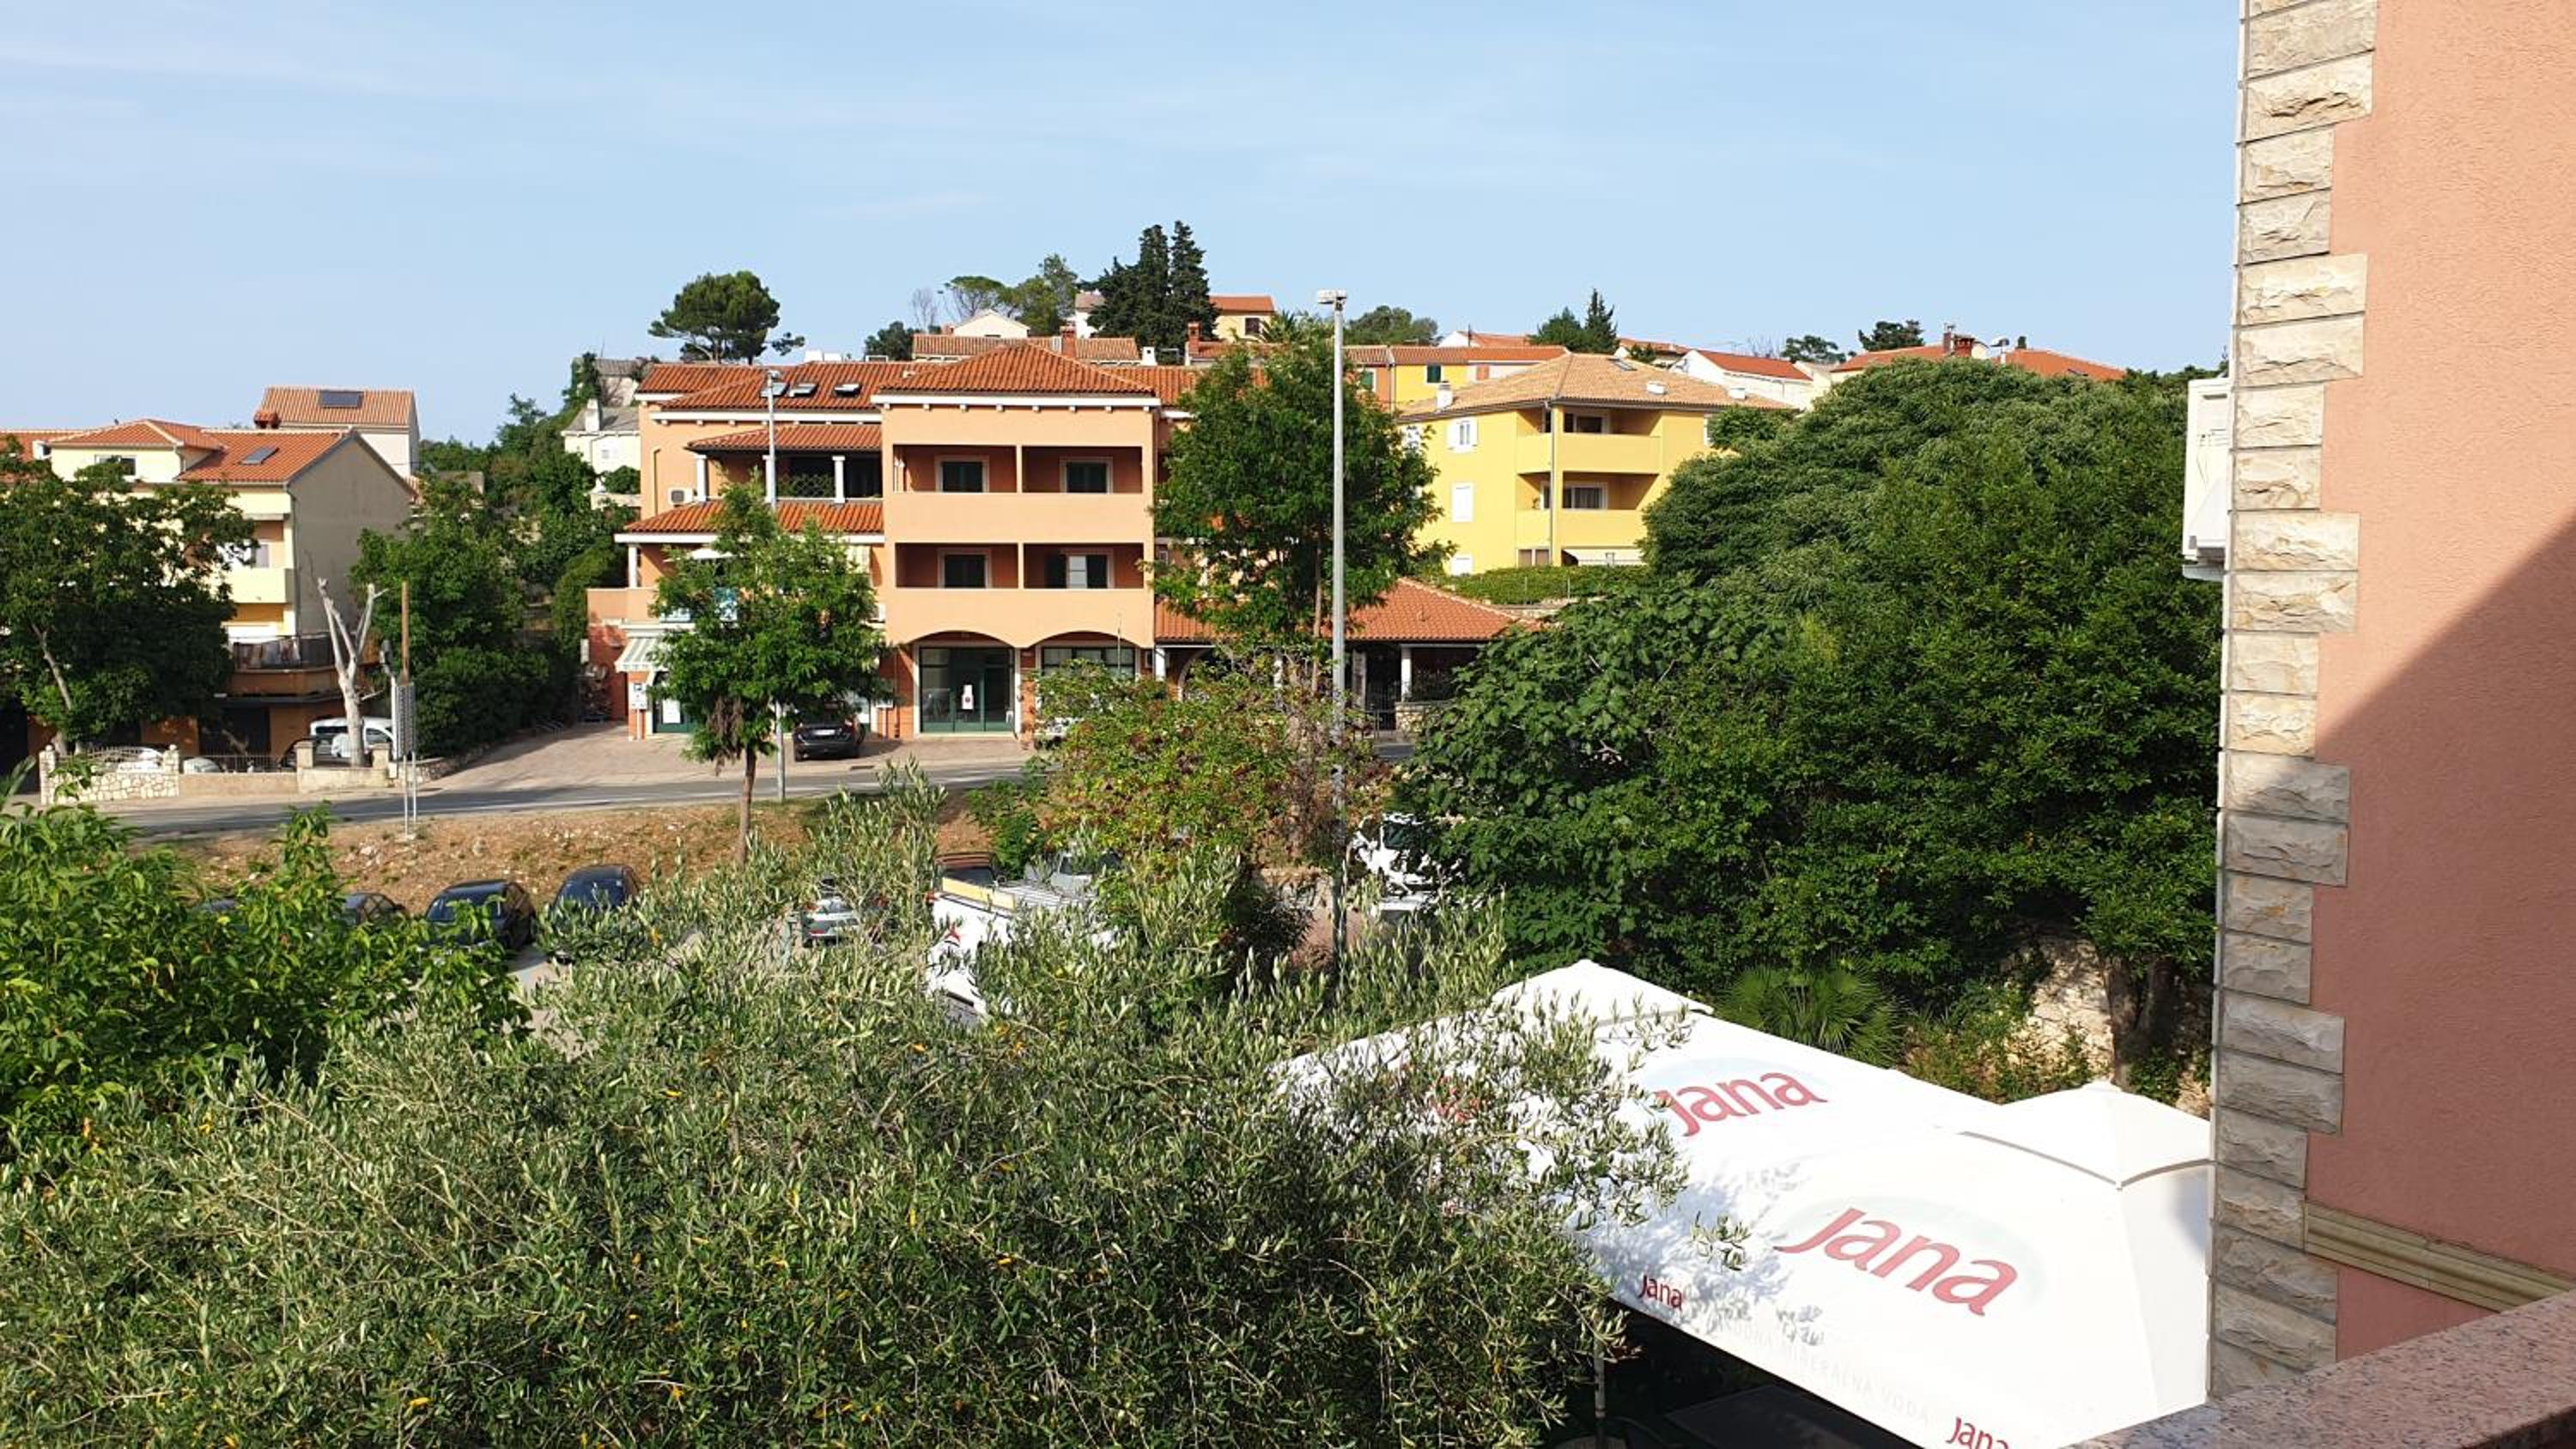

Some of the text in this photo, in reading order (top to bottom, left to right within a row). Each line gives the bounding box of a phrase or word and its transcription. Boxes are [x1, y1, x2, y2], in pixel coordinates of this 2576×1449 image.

[1653, 1072, 1828, 1137] Jana
[1637, 1274, 1683, 1311] Jana
[1771, 1207, 2018, 1317] Jana
